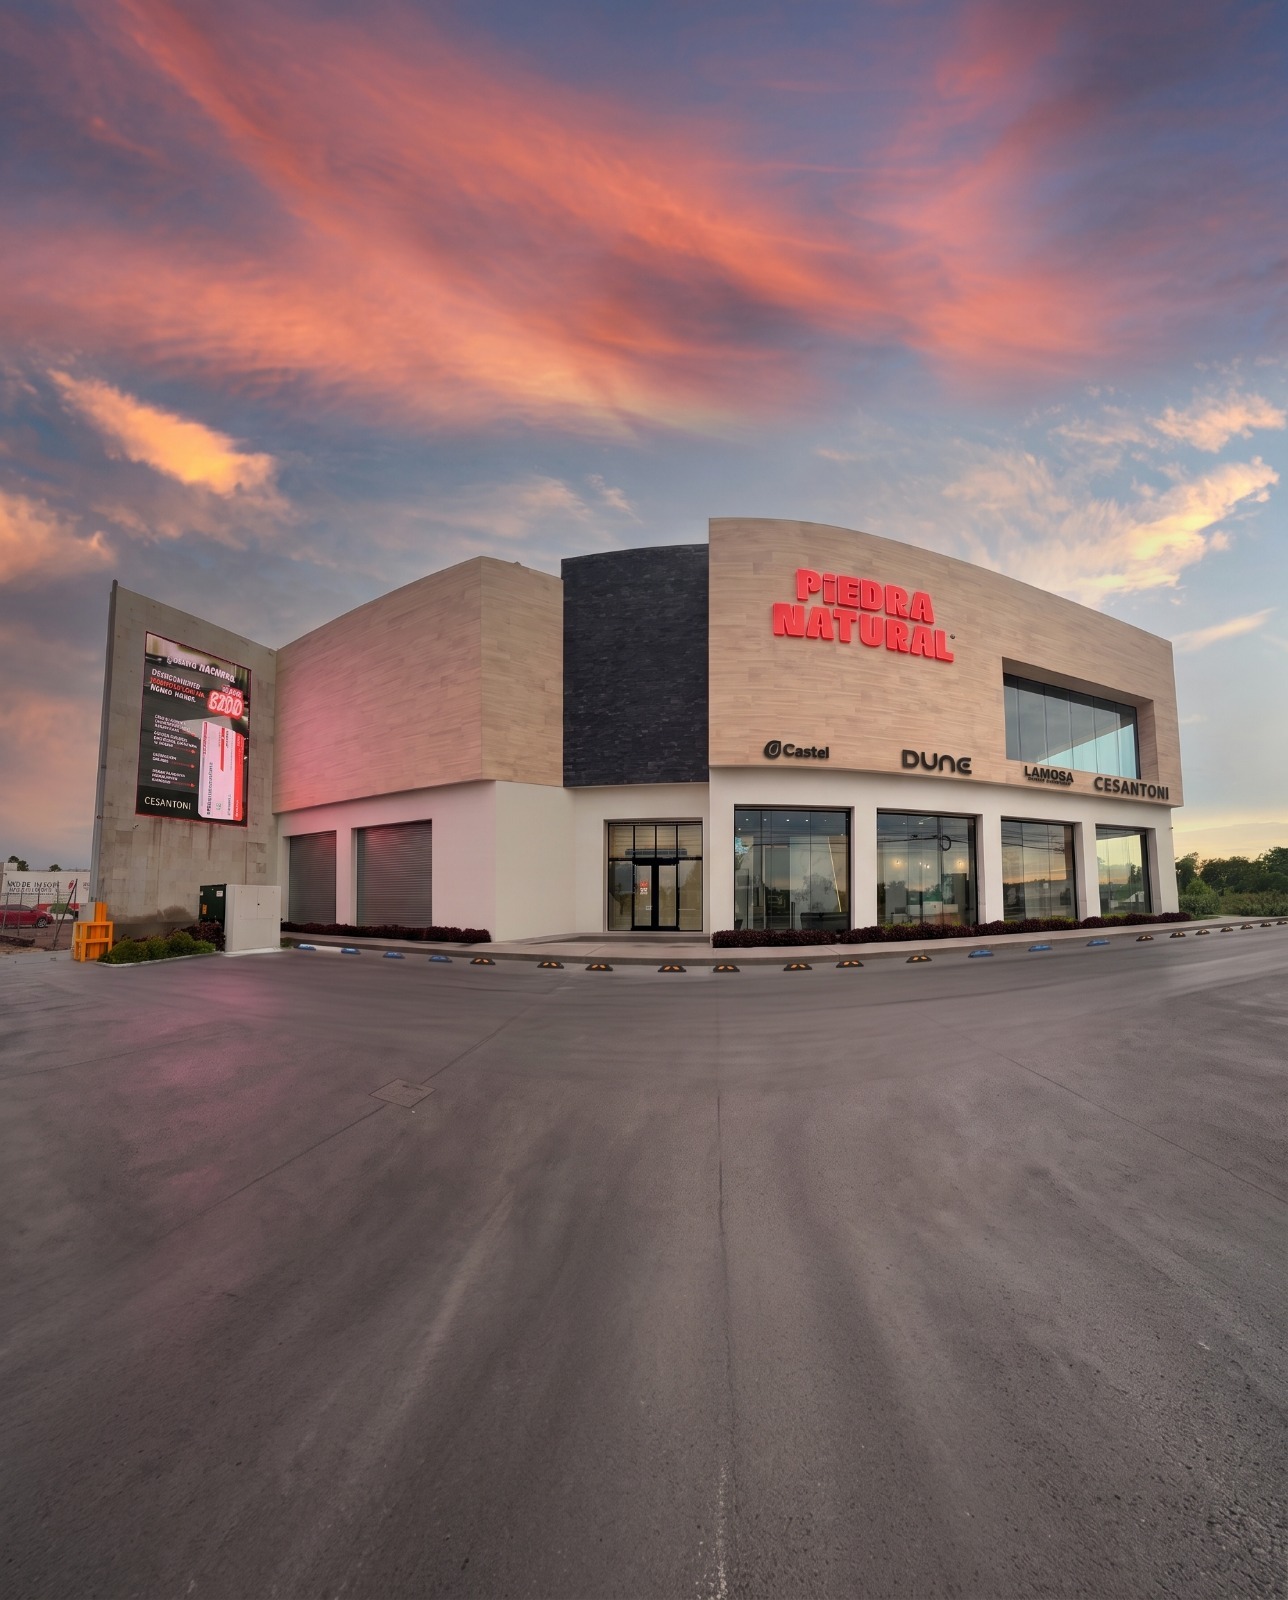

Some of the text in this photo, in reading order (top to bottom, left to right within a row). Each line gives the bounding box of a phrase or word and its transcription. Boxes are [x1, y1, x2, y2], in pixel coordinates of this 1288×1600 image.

[773, 603, 955, 663] NATURAL
[782, 743, 830, 759] Castel
[1024, 765, 1075, 783] LAMOSA
[1094, 776, 1169, 800] CESANTONI
[144, 796, 192, 811] CESANTONI
